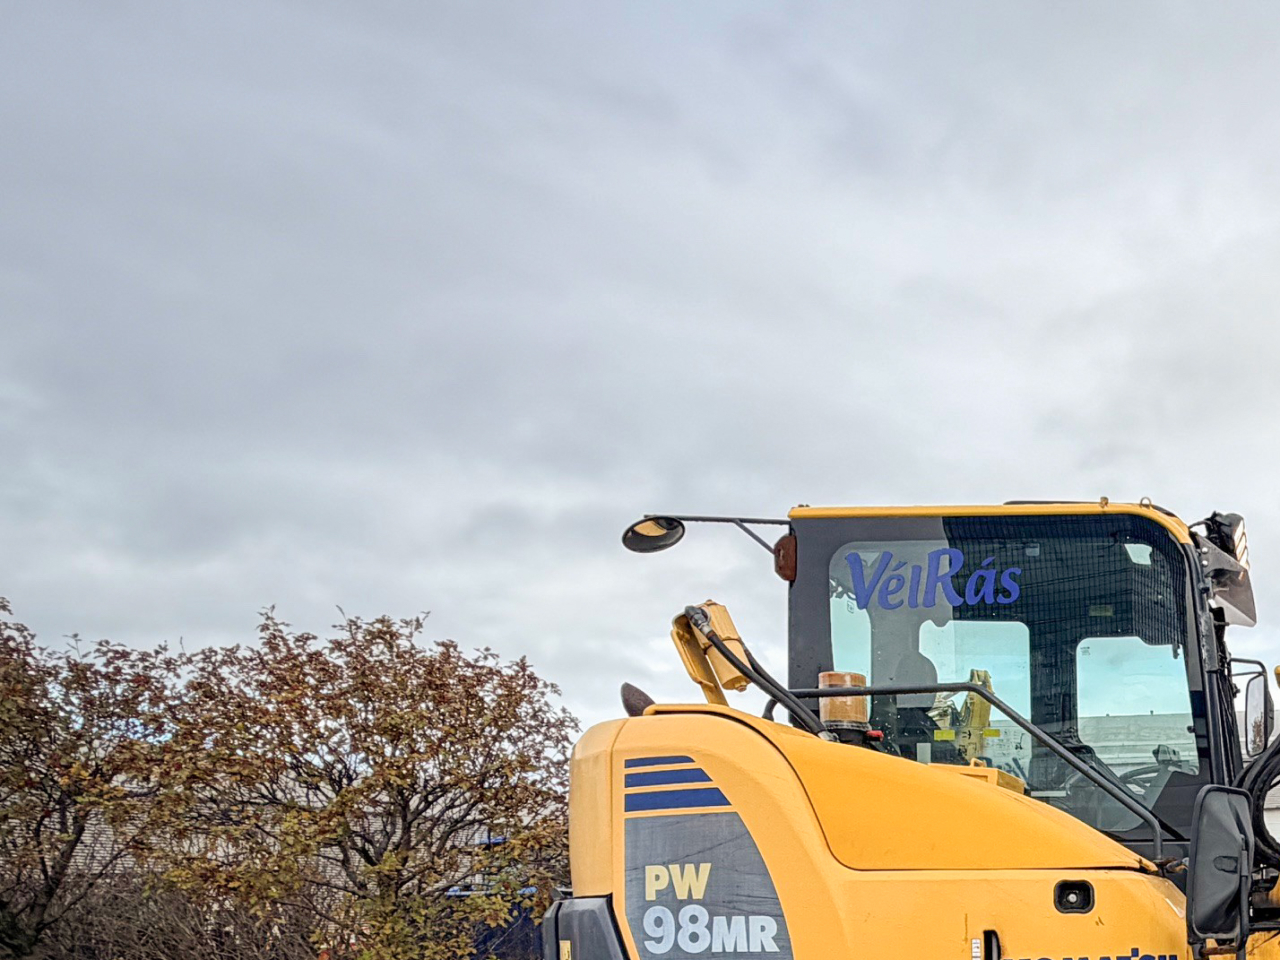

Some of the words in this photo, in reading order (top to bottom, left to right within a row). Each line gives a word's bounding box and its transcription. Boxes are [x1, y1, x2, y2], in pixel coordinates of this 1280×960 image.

[844, 547, 1022, 610] VélRás
[644, 862, 712, 901] PW
[642, 903, 781, 955] 98MR
